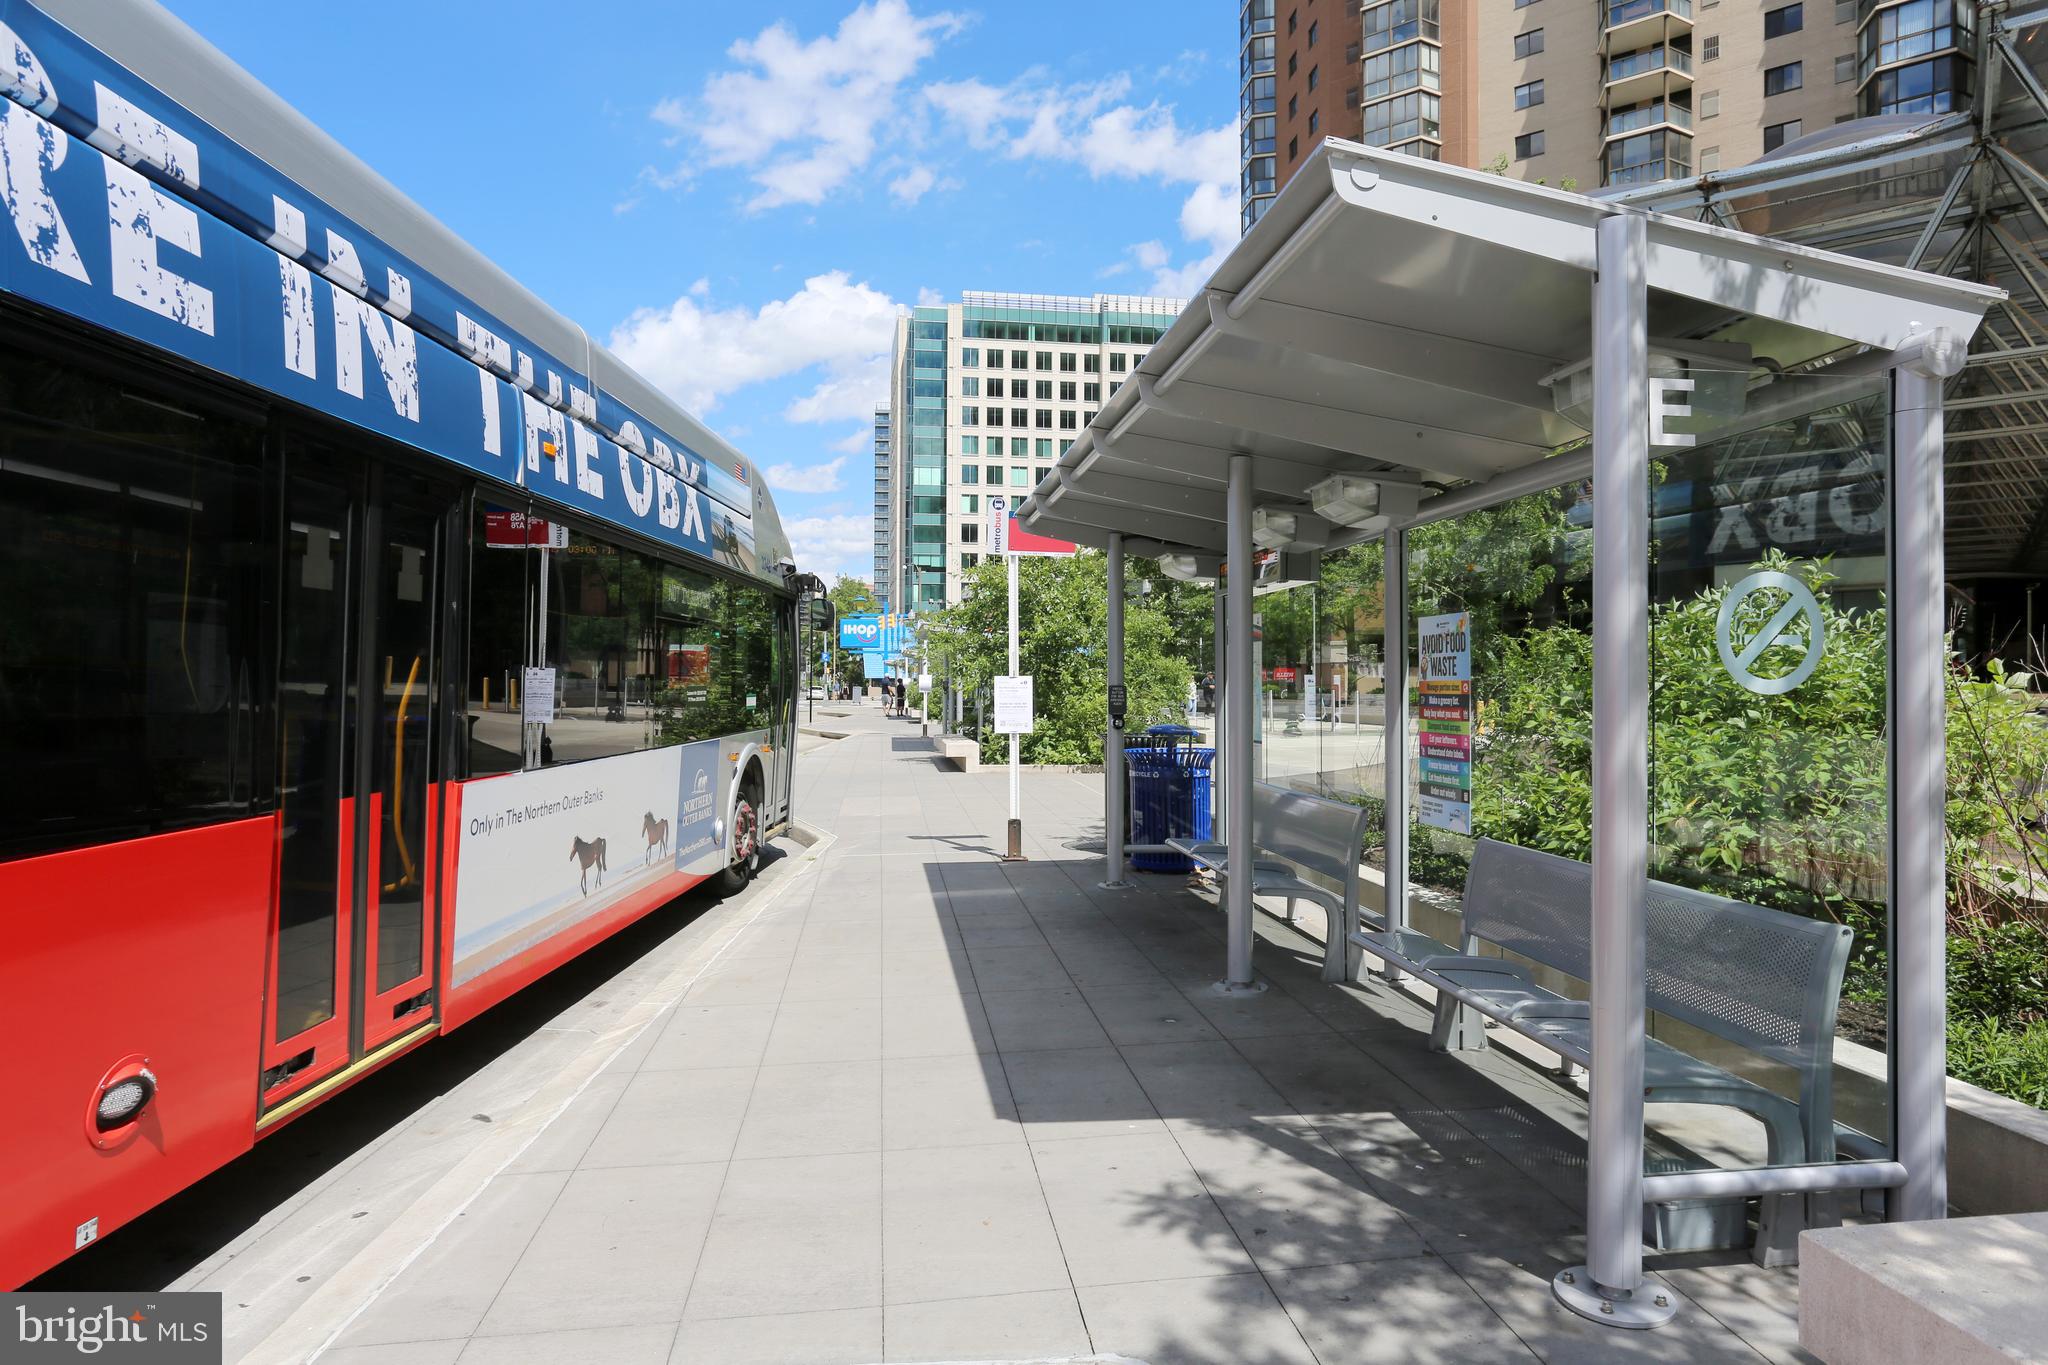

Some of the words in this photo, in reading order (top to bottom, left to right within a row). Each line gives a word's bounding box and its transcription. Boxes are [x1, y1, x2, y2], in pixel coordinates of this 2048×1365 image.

[266, 194, 420, 423] IN
[456, 311, 604, 499] THE
[617, 420, 707, 542] OBX
[1649, 378, 1696, 447] E
[1422, 633, 1443, 654] AVOID
[1445, 632, 1466, 653] FOOD
[1430, 656, 1457, 676] WASTE
[470, 813, 494, 837] Only
[495, 810, 504, 829] in
[506, 807, 522, 826] The
[524, 801, 561, 822] Northern
[562, 794, 583, 814] Outer
[584, 789, 604, 805] Banks
[683, 792, 713, 814] NORTHERN
